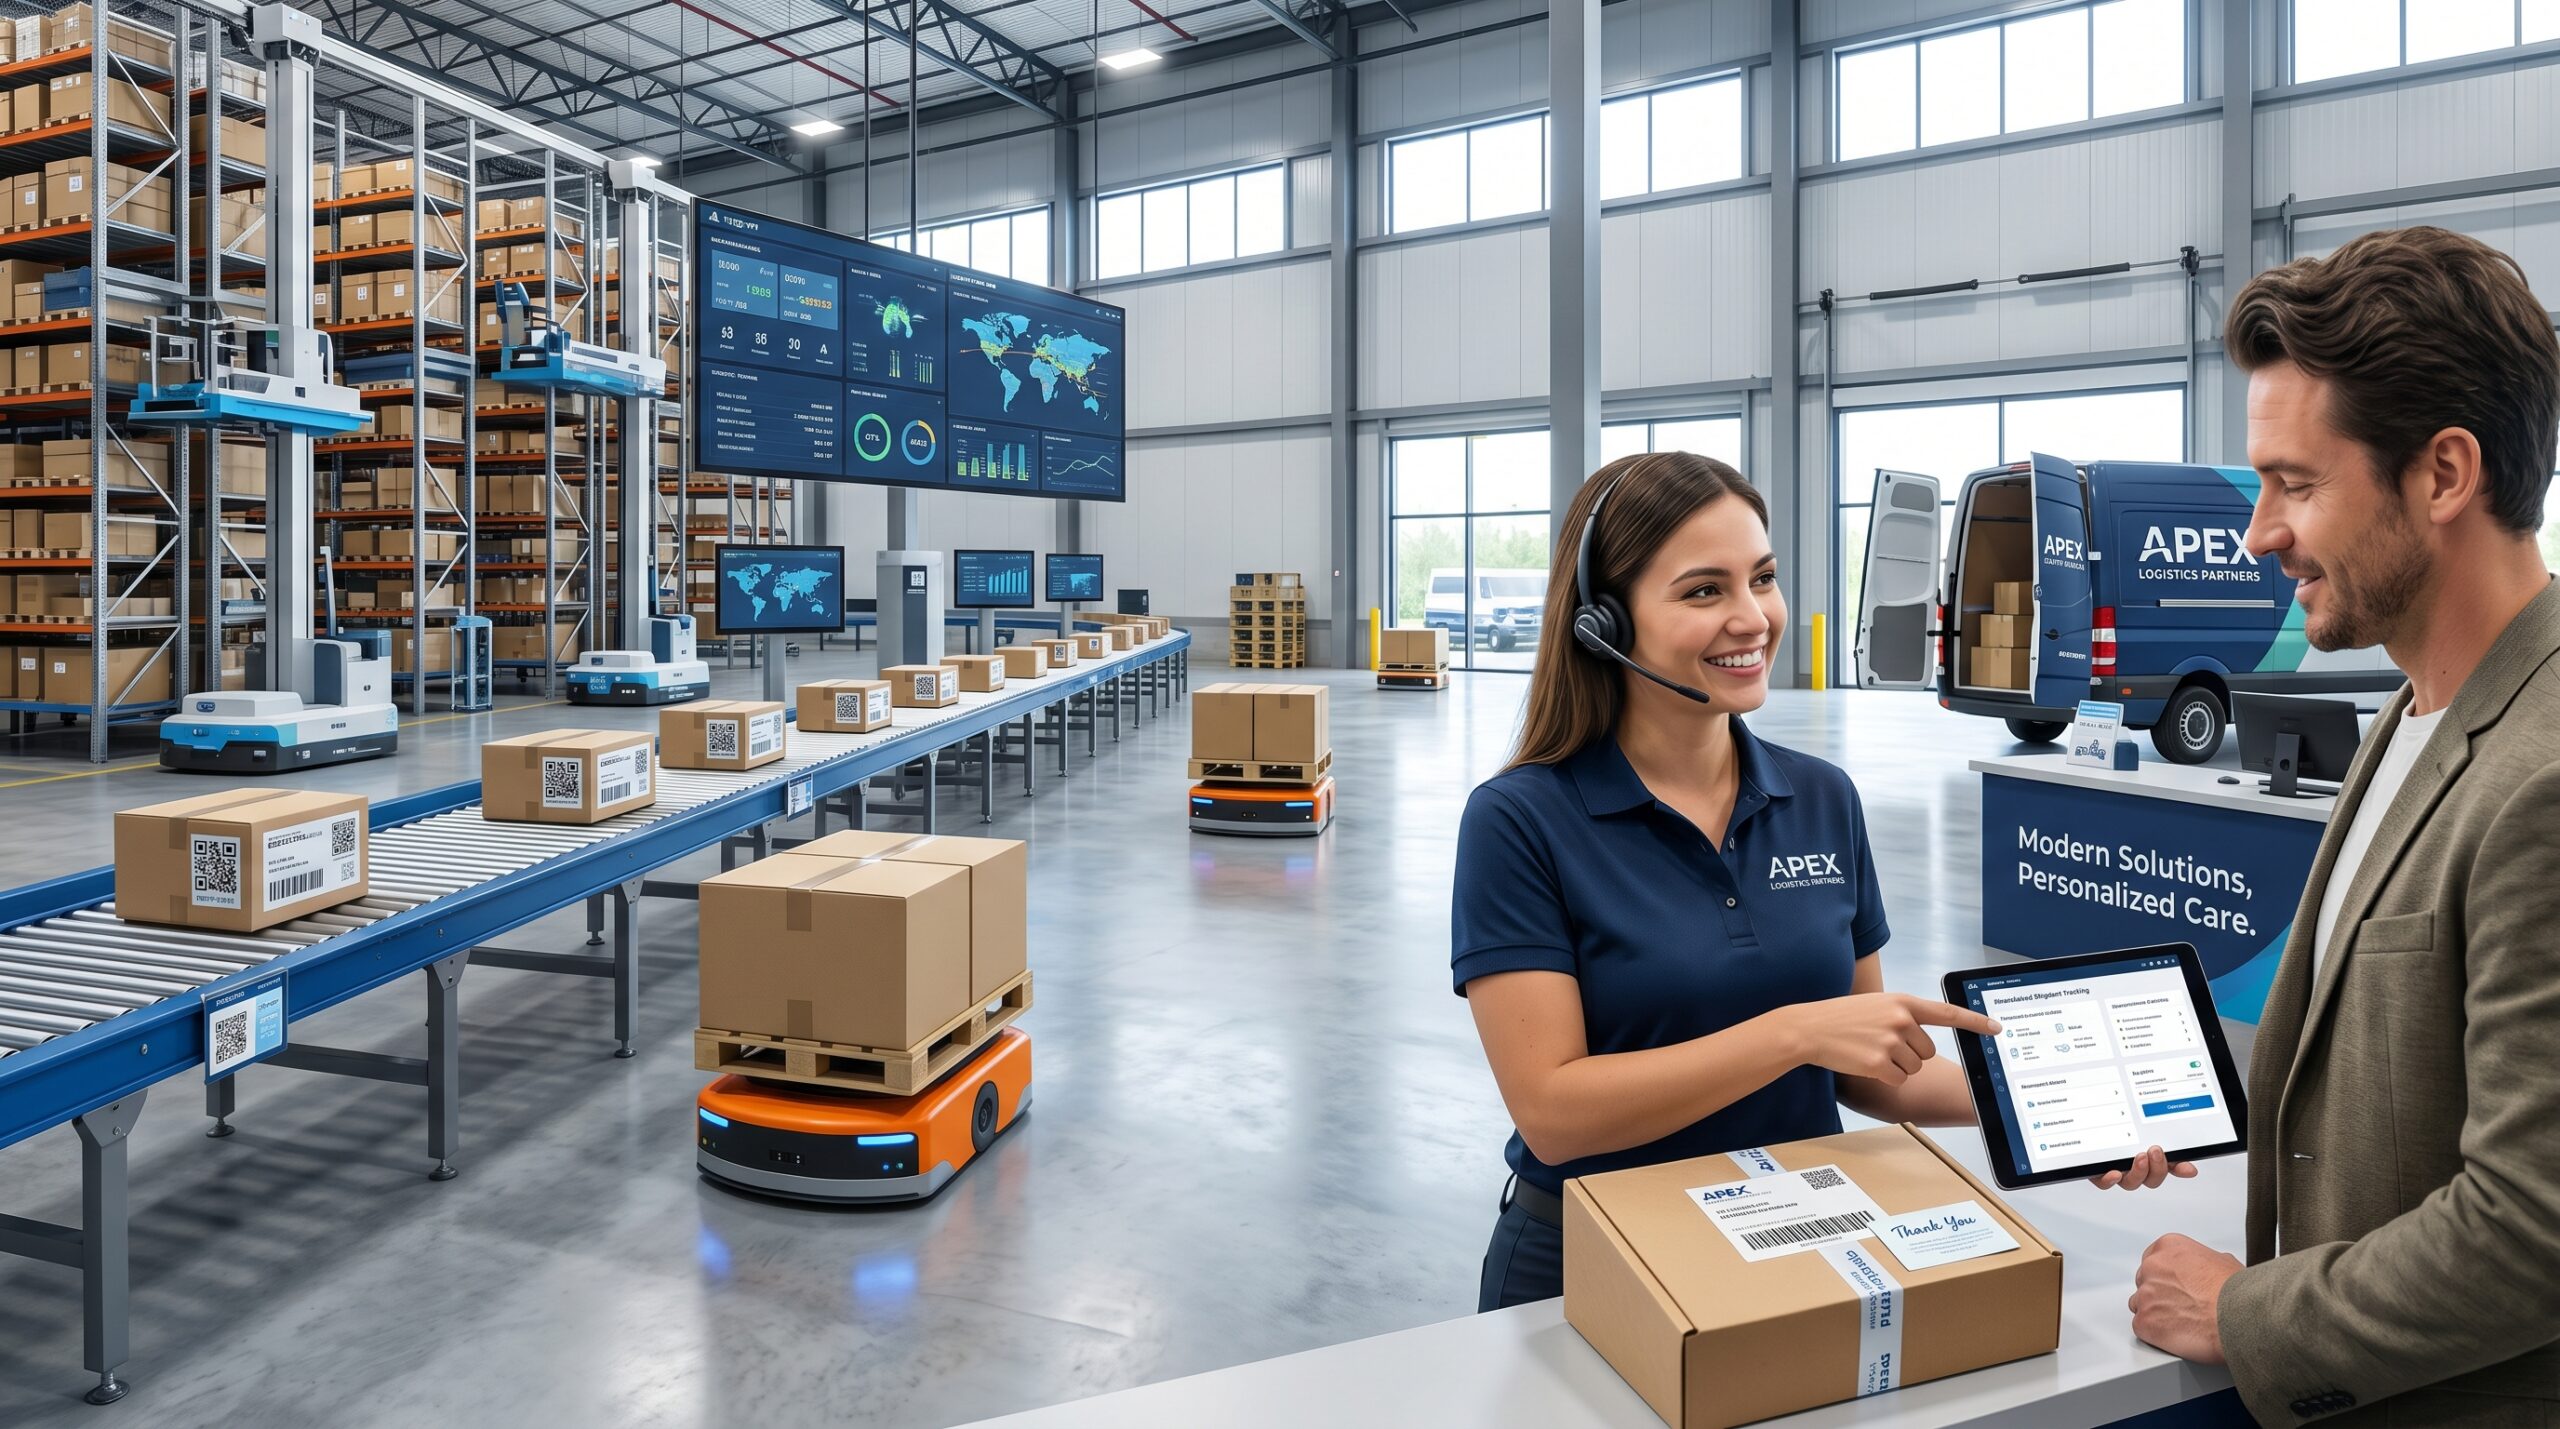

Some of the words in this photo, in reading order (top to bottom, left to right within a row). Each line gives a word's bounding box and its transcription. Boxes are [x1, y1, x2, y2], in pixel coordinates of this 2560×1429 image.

[2043, 534, 2084, 562] APEX
[2138, 526, 2259, 566] APEX
[2138, 568, 2199, 580] LOGISTICS
[2201, 569, 2261, 582] PARTNERS
[1768, 853, 1843, 879] APEX
[2018, 825, 2110, 868] Modern
[2118, 845, 2253, 900] Solutions,
[2018, 861, 2175, 919] Personalized
[2184, 897, 2257, 937] Care.
[1703, 1184, 1748, 1201] APEX
[1891, 1219, 1943, 1239] Thank
[1943, 1215, 1977, 1232] You
